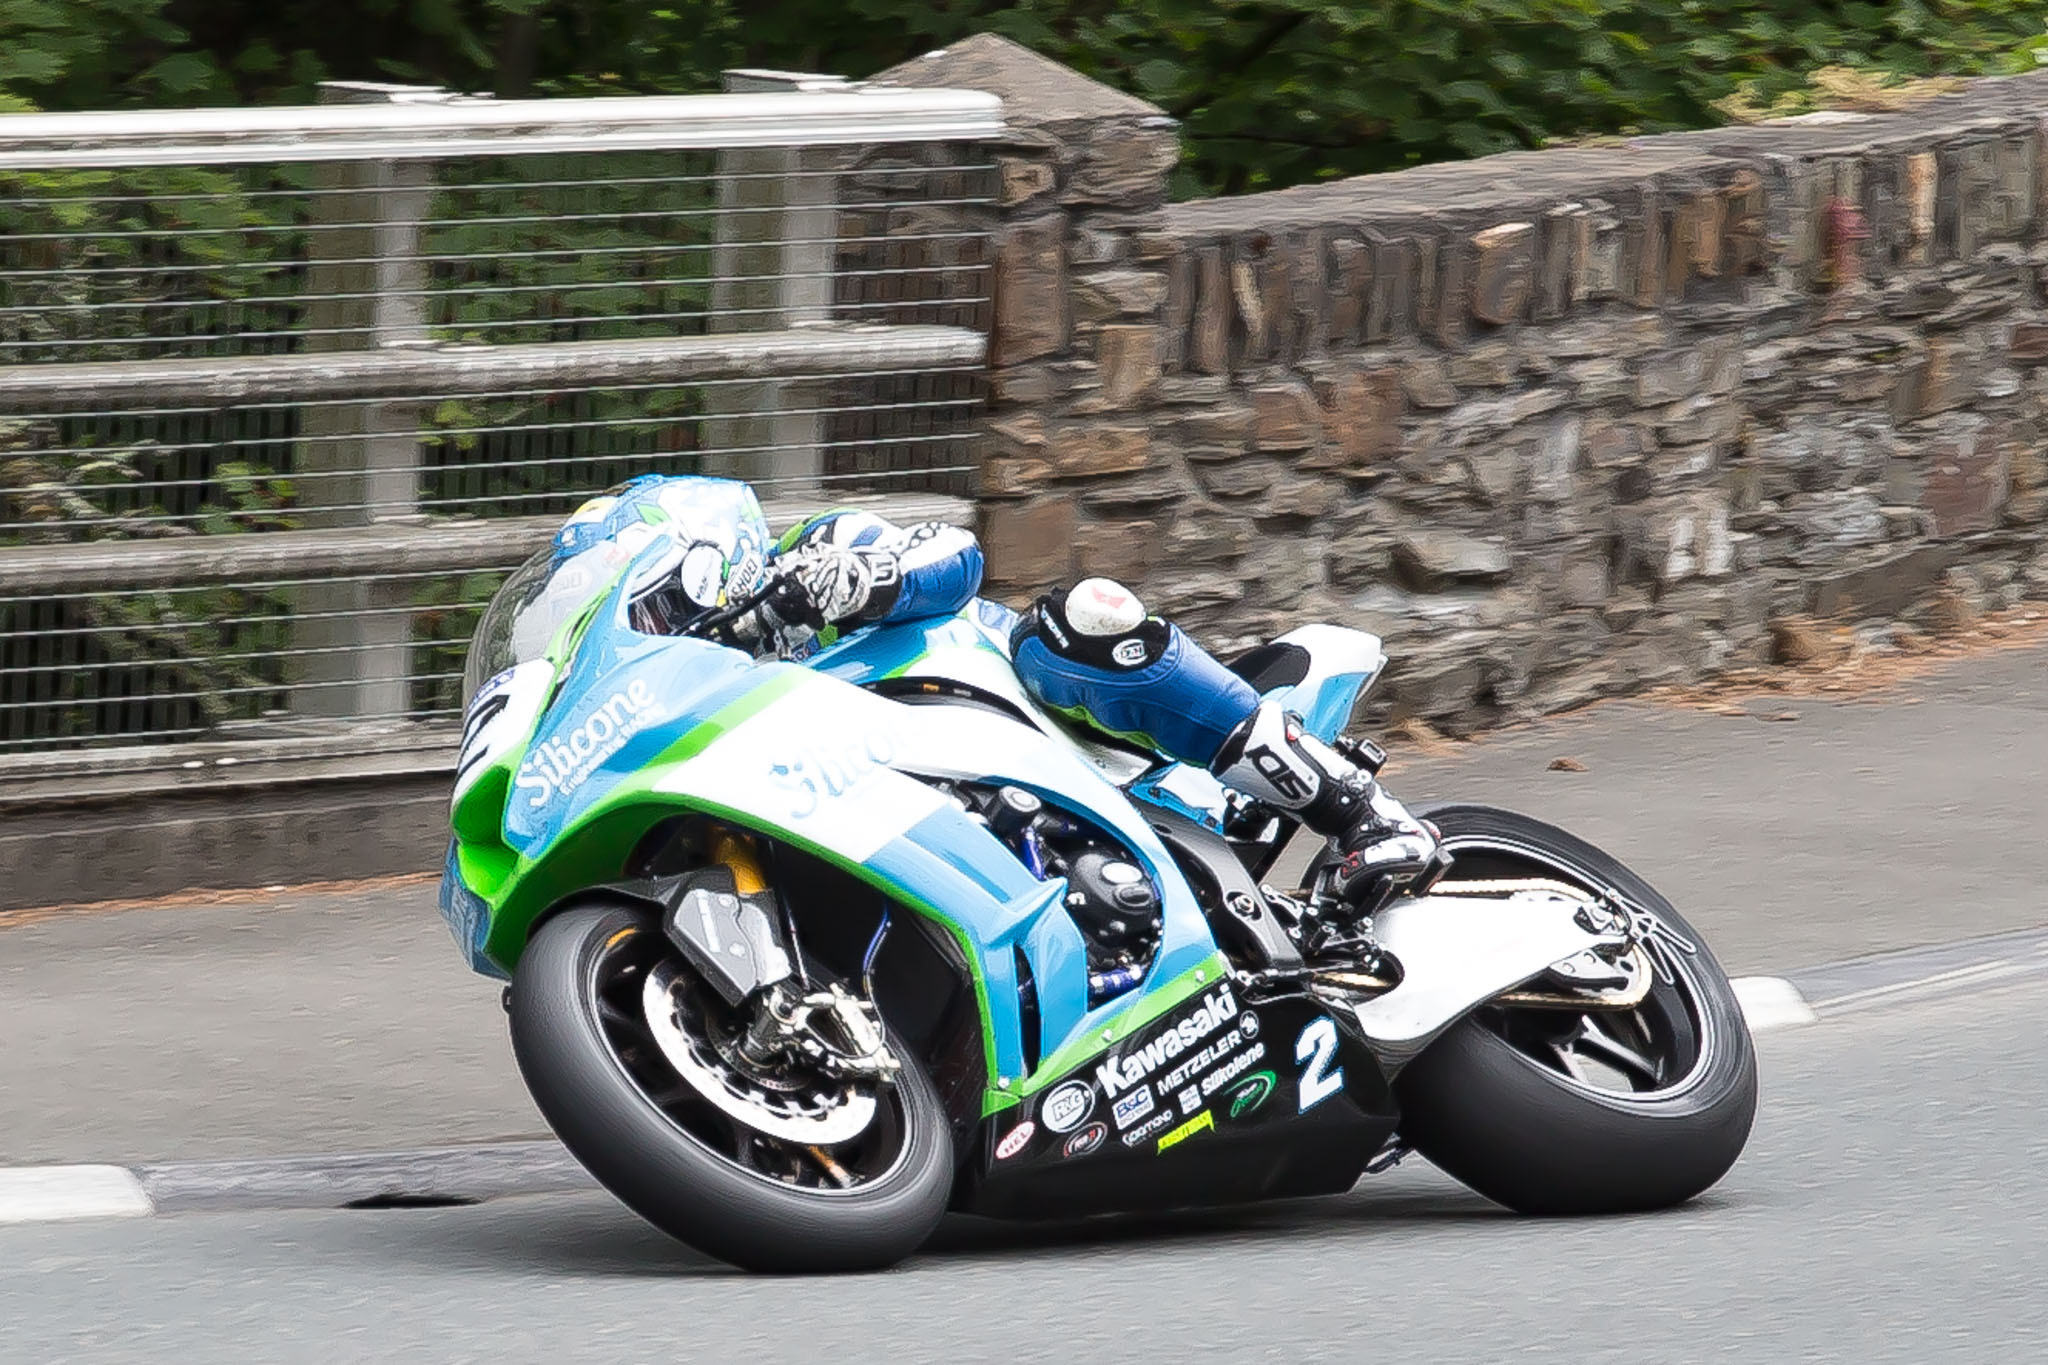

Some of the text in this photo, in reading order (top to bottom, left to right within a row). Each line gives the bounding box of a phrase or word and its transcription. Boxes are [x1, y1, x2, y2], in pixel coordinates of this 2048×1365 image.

[515, 679, 656, 807] Silicone
[1096, 983, 1238, 1098] Kawasaki
[1156, 1030, 1242, 1096] METZELER
[1294, 1014, 1344, 1115] 2
